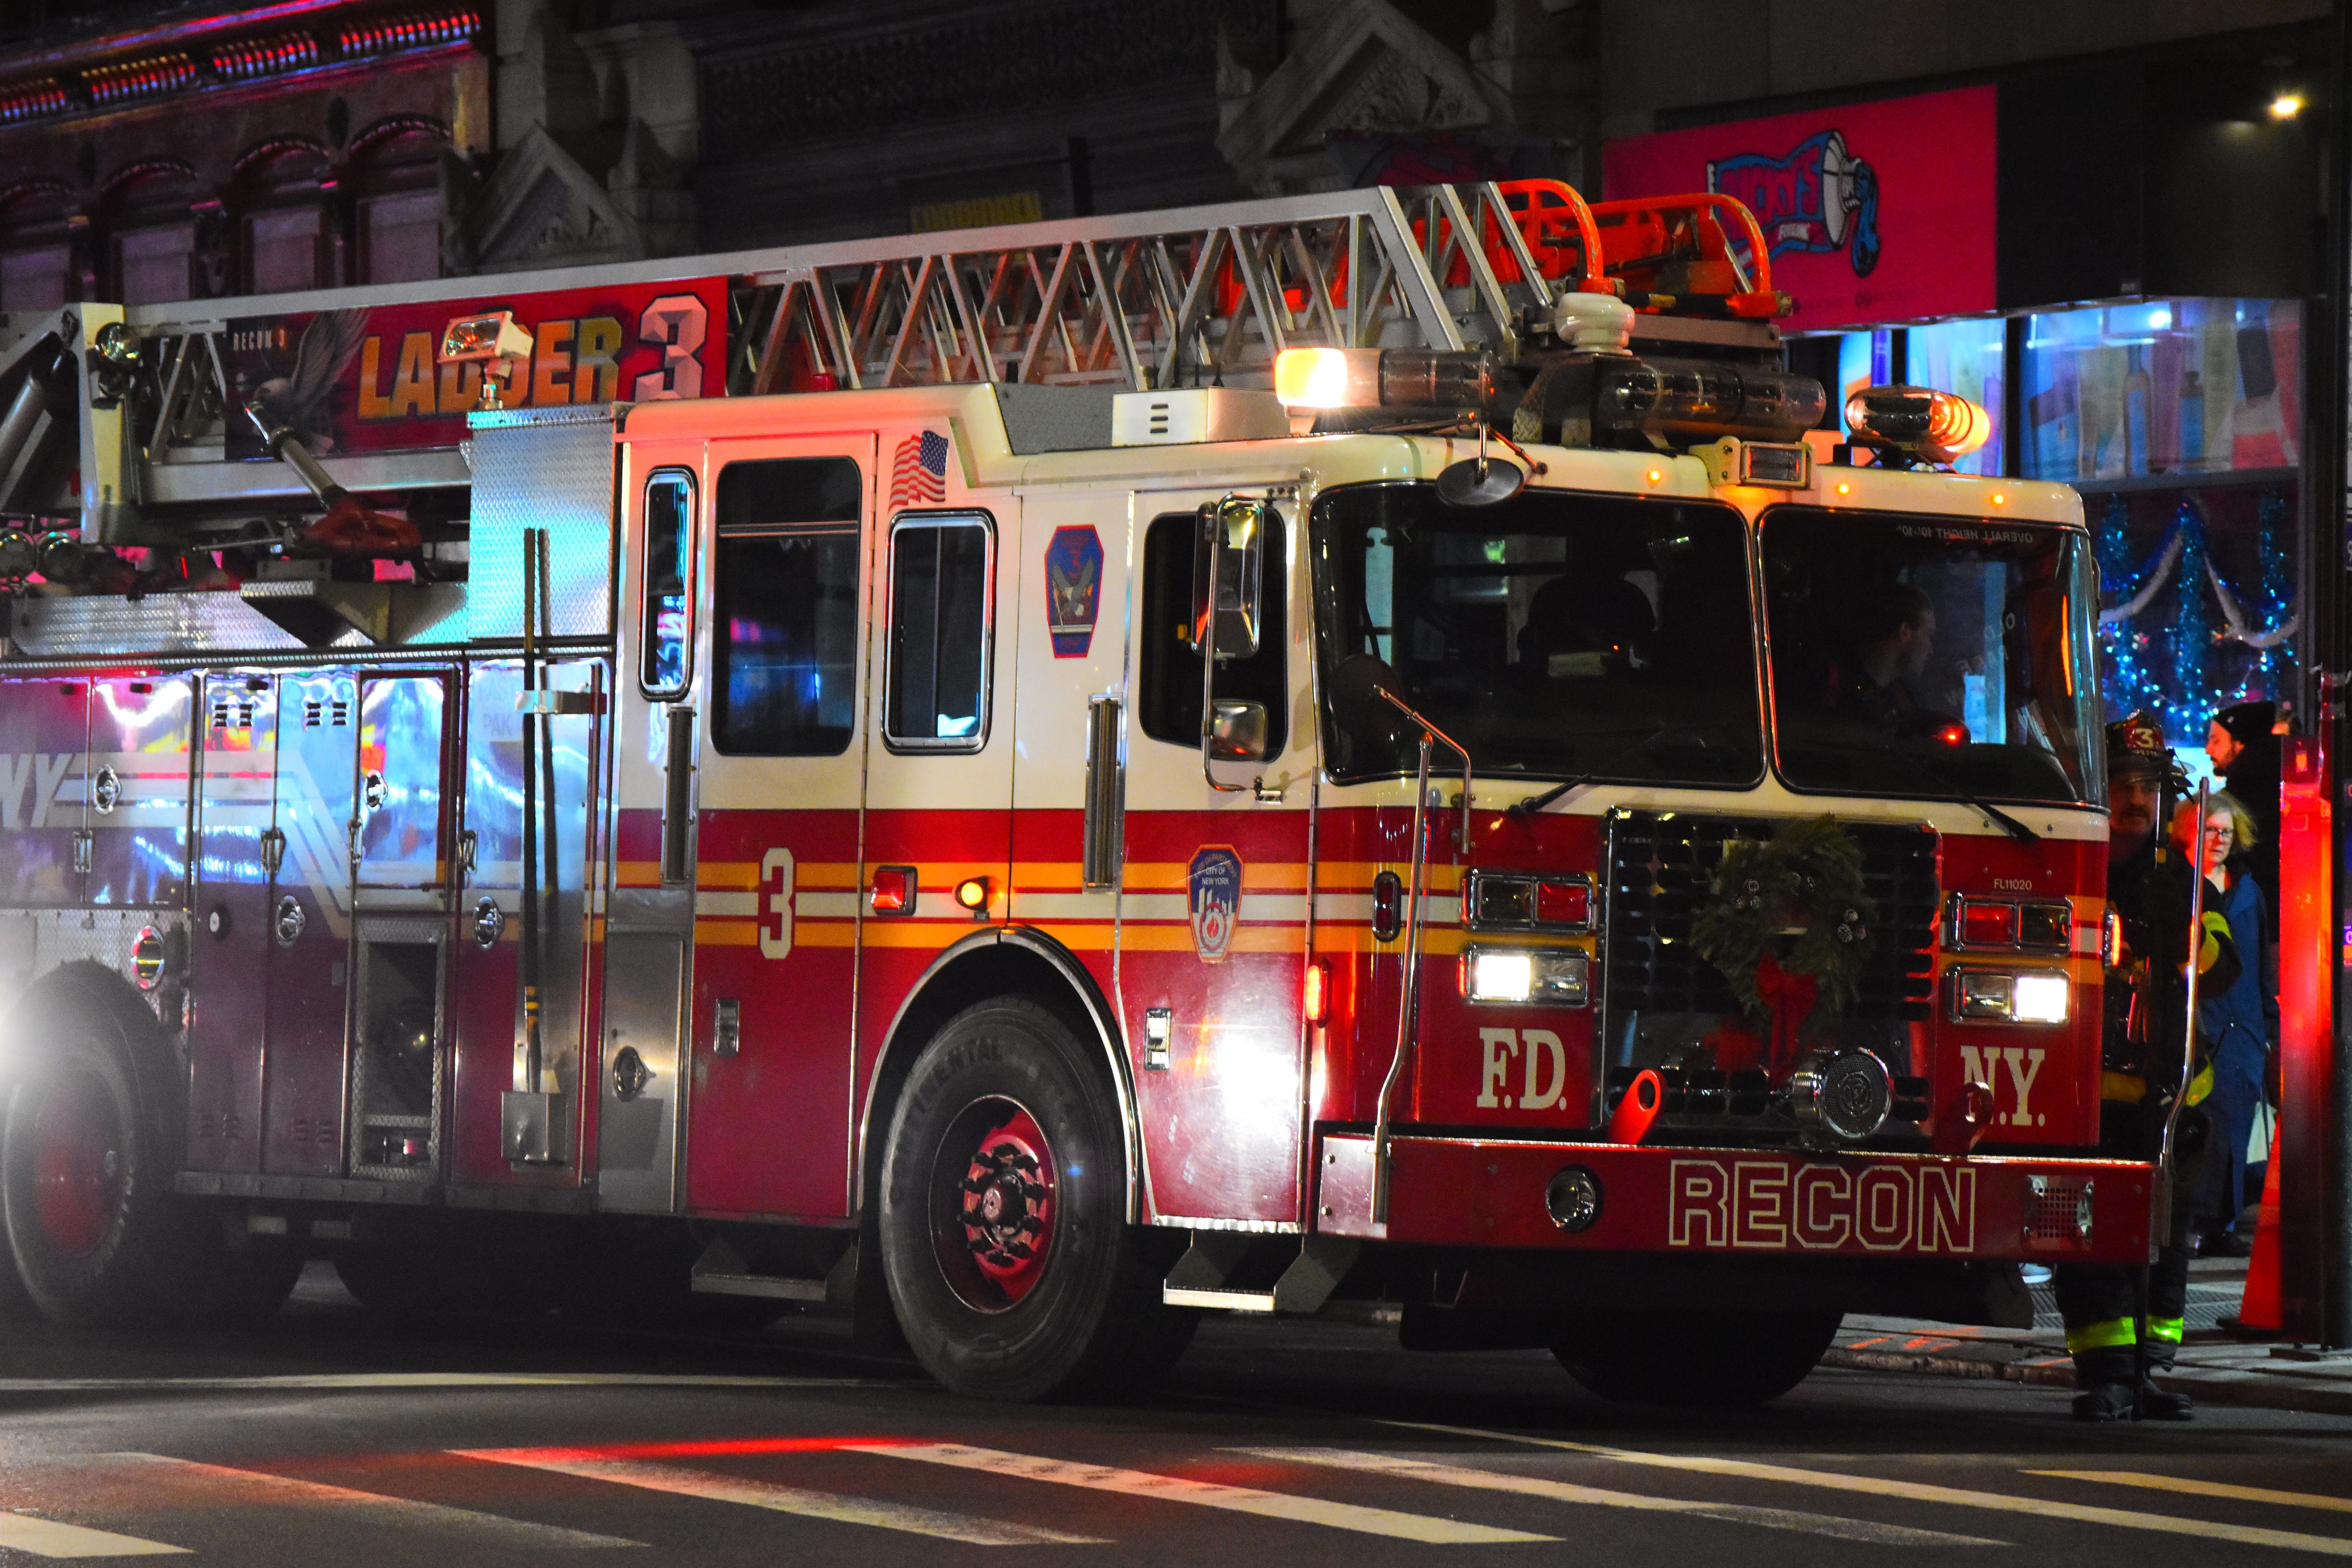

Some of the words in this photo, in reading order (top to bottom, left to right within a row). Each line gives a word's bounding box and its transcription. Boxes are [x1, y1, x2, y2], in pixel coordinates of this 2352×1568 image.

[233, 330, 272, 352] RECON
[636, 294, 707, 401] 3
[2135, 728, 2154, 748] 3
[1206, 866, 1217, 875] CITY
[1218, 866, 1226, 875] OF
[1994, 878, 2032, 891] FL11020
[760, 848, 794, 959] 3
[1477, 1027, 1567, 1110] F.D.
[1668, 1158, 1976, 1253] RECON
